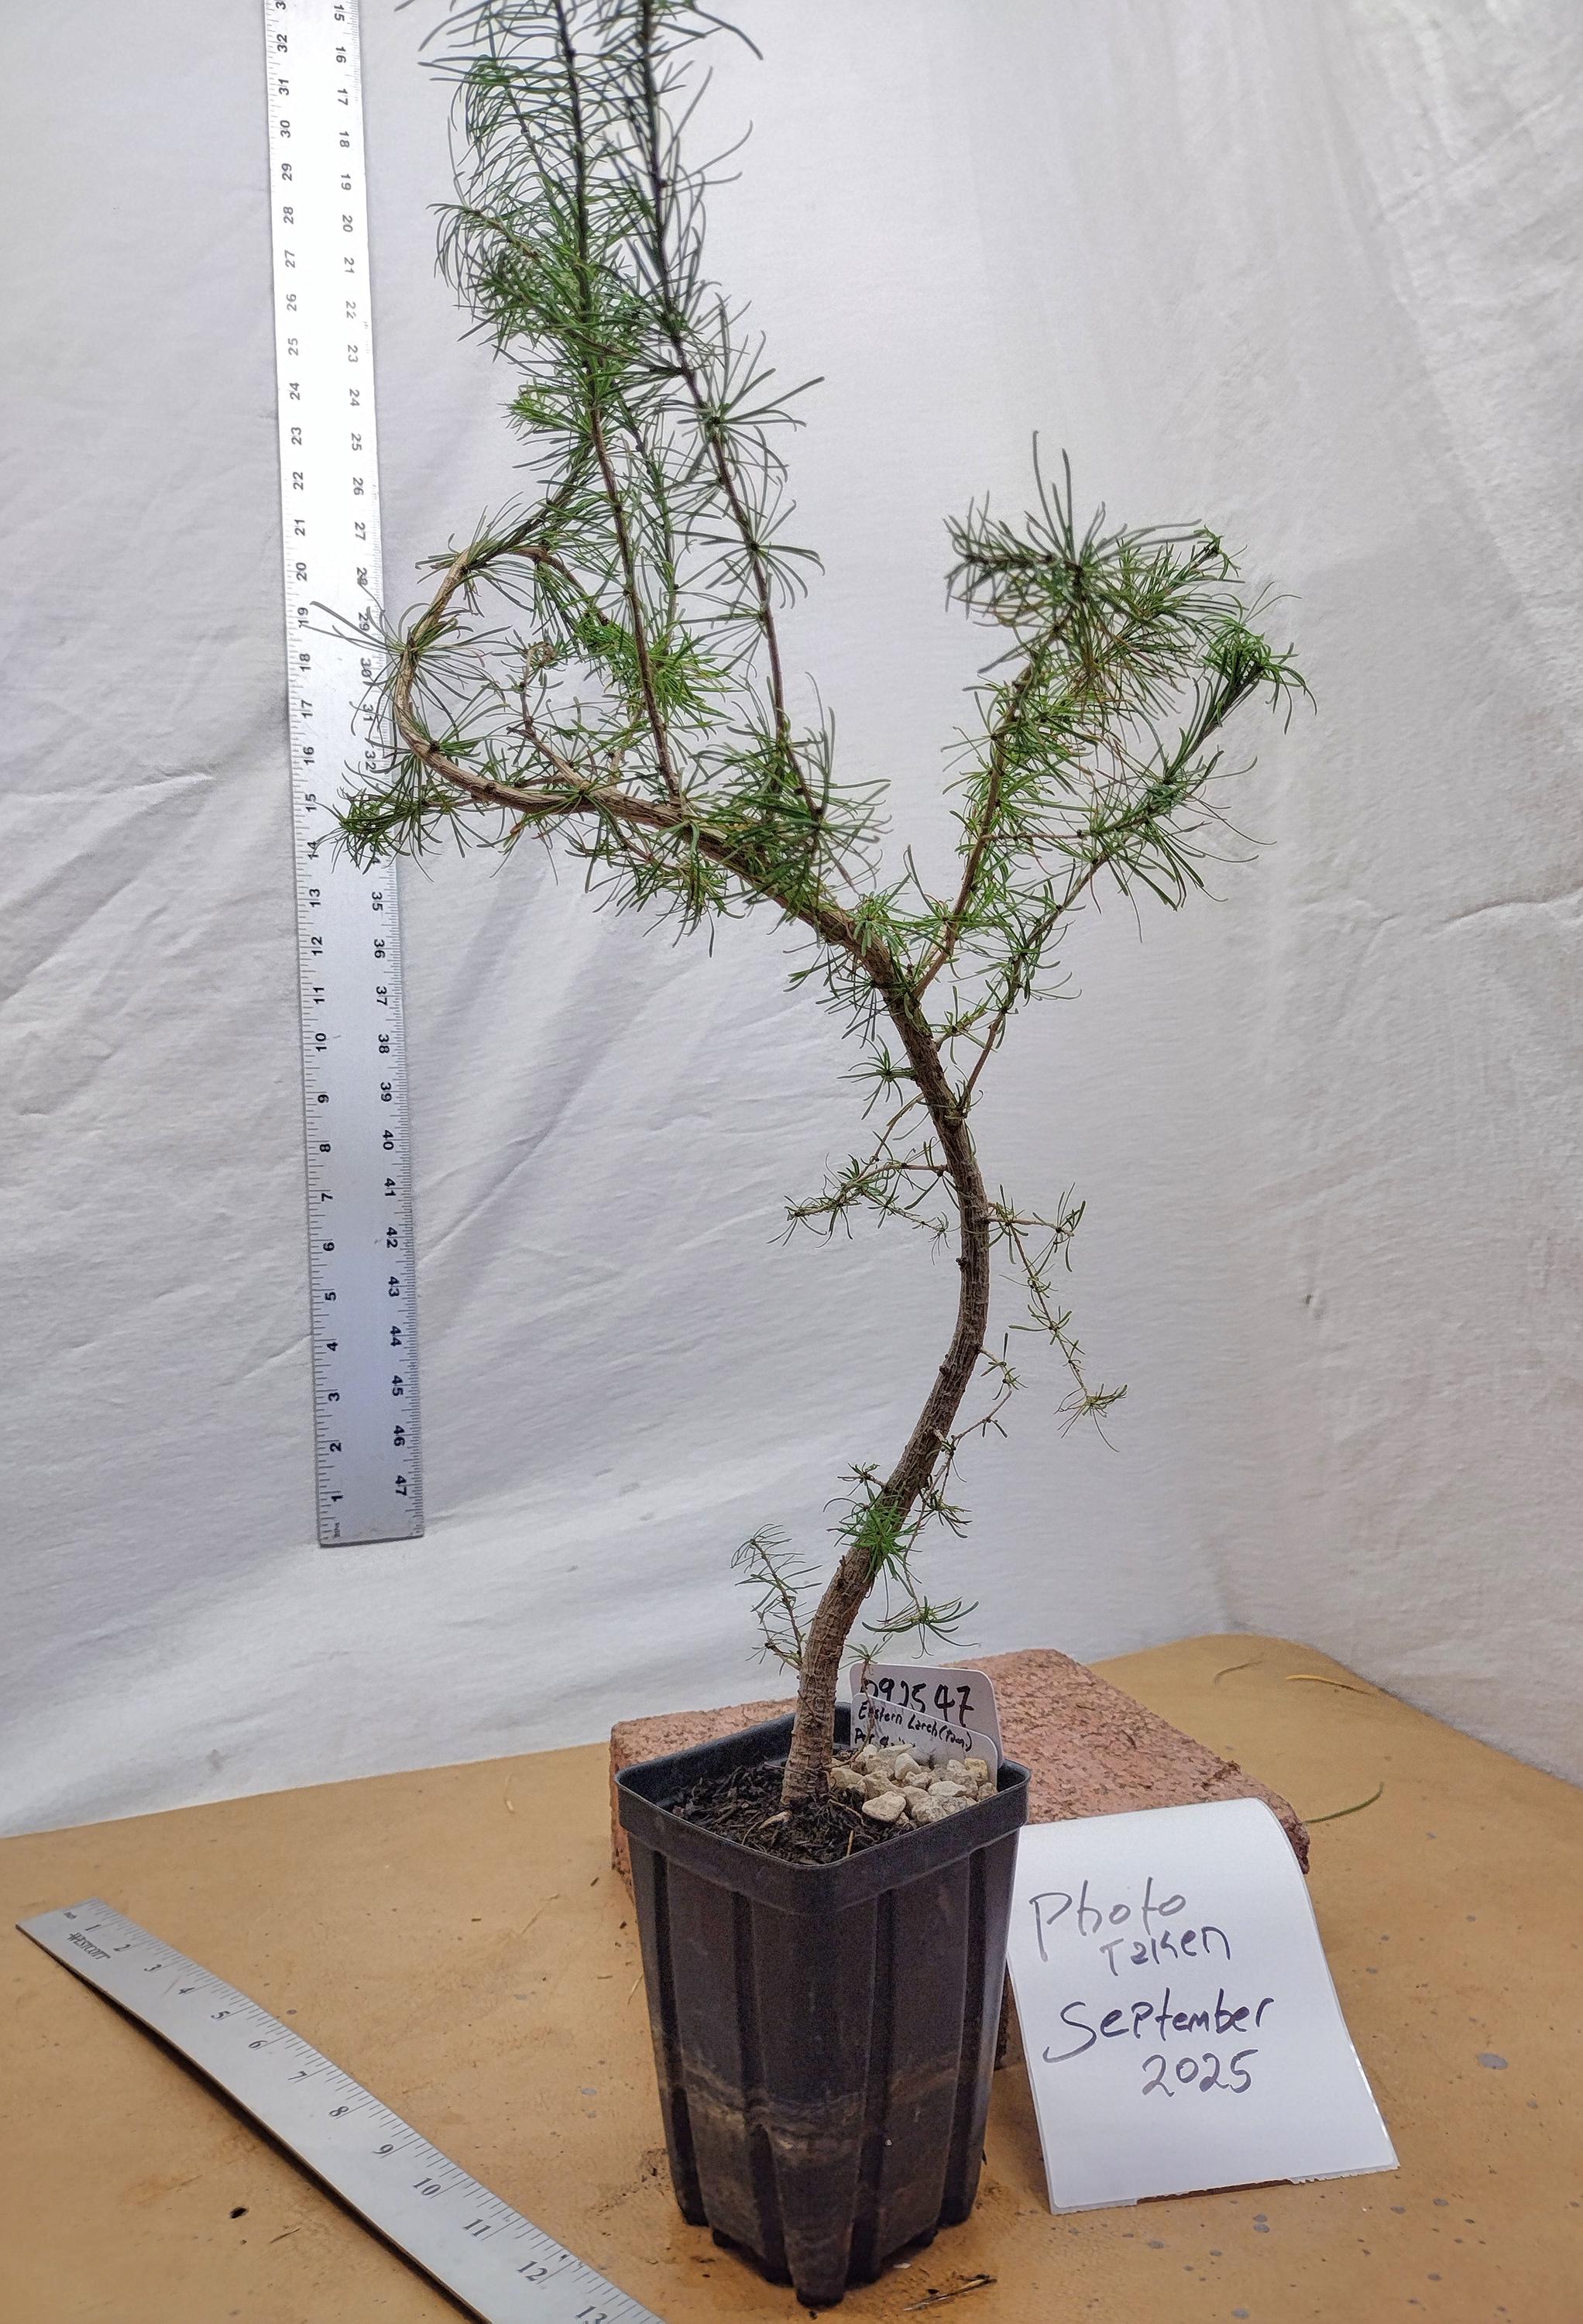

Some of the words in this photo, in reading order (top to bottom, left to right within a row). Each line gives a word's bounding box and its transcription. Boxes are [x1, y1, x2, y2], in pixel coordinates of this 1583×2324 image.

[334, 5, 345, 22] 15
[276, 34, 287, 53] 32
[336, 46, 346, 64] 16
[278, 78, 289, 95] 31
[338, 88, 349, 105] 17
[280, 120, 290, 138] 30
[339, 131, 350, 148] 18
[282, 163, 292, 181] 29
[341, 174, 352, 191] 19
[283, 207, 294, 225] 28
[342, 215, 353, 232] 20
[285, 250, 295, 268] 27
[344, 257, 355, 273] 21
[287, 294, 297, 311] 26
[346, 301, 356, 319] 22
[288, 339, 298, 356] 25
[348, 345, 359, 363] 23
[290, 383, 300, 401] 24
[349, 389, 360, 407] 24
[291, 427, 301, 445] 23
[351, 433, 362, 451] 25
[293, 472, 304, 490] 22
[353, 477, 364, 496] 26
[294, 519, 305, 536] 21
[355, 521, 366, 541] 27
[297, 562, 307, 581] 20
[298, 607, 309, 627] 19
[358, 613, 370, 631] 29
[300, 653, 311, 672] 18
[361, 658, 372, 678] 30
[301, 700, 313, 718] 17
[363, 703, 374, 722] 31
[303, 747, 314, 765] 16
[365, 751, 376, 770] 32
[305, 794, 317, 812] 15
[307, 841, 319, 860] 14
[310, 889, 321, 907] 13
[372, 891, 383, 911] 35
[311, 937, 323, 956] 12
[374, 939, 385, 959] 36
[313, 987, 324, 1004] 11
[376, 985, 387, 1006] 37
[315, 1033, 327, 1052] 10
[378, 1034, 390, 1054] 38
[318, 1094, 329, 1103] 9
[380, 1081, 392, 1102] 39
[319, 1143, 331, 1153] 8
[383, 1129, 394, 1150] 40
[384, 1177, 396, 1197] 41
[321, 1193, 333, 1202] 7
[386, 1226, 398, 1248] 42
[323, 1242, 335, 1252] 6
[388, 1276, 400, 1297] 43
[324, 1292, 336, 1301] 5
[390, 1325, 402, 1346] 44
[326, 1342, 338, 1351] 4
[392, 1375, 403, 1396] 45
[328, 1392, 340, 1402] 3
[393, 1425, 405, 1446] 46
[330, 1442, 342, 1452] 2
[395, 1475, 407, 1496] 47
[1029, 1877, 1186, 1962] Photo
[1100, 1926, 1231, 1977] Taken
[1042, 1988, 1274, 2063] September
[1142, 2049, 1259, 2097] 2025
[114, 1944, 131, 1952] 2
[144, 1964, 162, 1973] 3
[178, 1986, 195, 1996] 4
[211, 2010, 231, 2020] 5
[249, 2040, 268, 2050] 6
[288, 2071, 307, 2082] 7
[328, 2106, 349, 2117] 8
[373, 2144, 394, 2155] 9
[413, 2178, 441, 2196] 10
[463, 2218, 492, 2237] 11
[517, 2260, 548, 2281] 12
